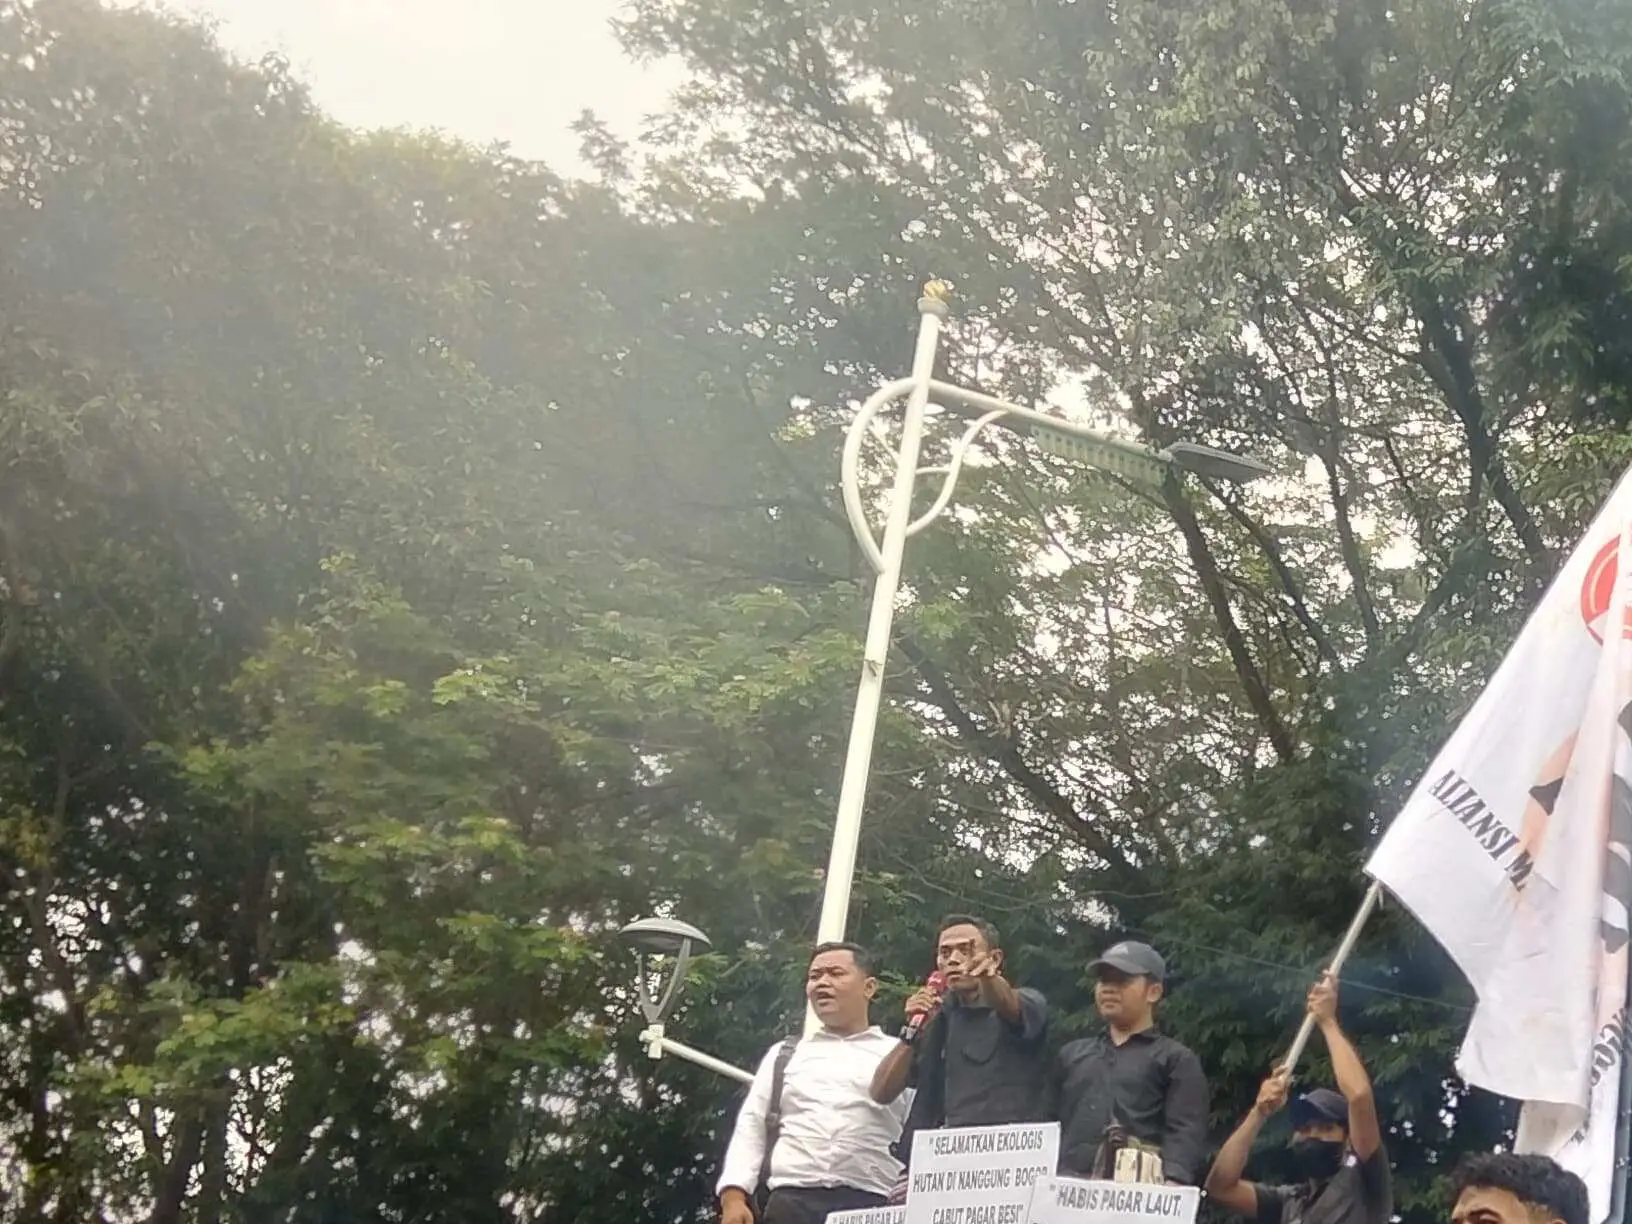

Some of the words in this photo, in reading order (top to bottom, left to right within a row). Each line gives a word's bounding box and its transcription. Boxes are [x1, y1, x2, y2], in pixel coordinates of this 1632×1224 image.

[1427, 770, 1520, 861] ALIANSI
[934, 1132, 995, 1155] SELAMATKAN
[997, 1130, 1043, 1152] EKOLOGIS
[912, 1172, 944, 1193] HUTAN
[946, 1171, 956, 1191] DI
[958, 1168, 1011, 1190] NANGGUNG
[1056, 1184, 1098, 1210] HABIS
[1100, 1189, 1144, 1213] PAGAR
